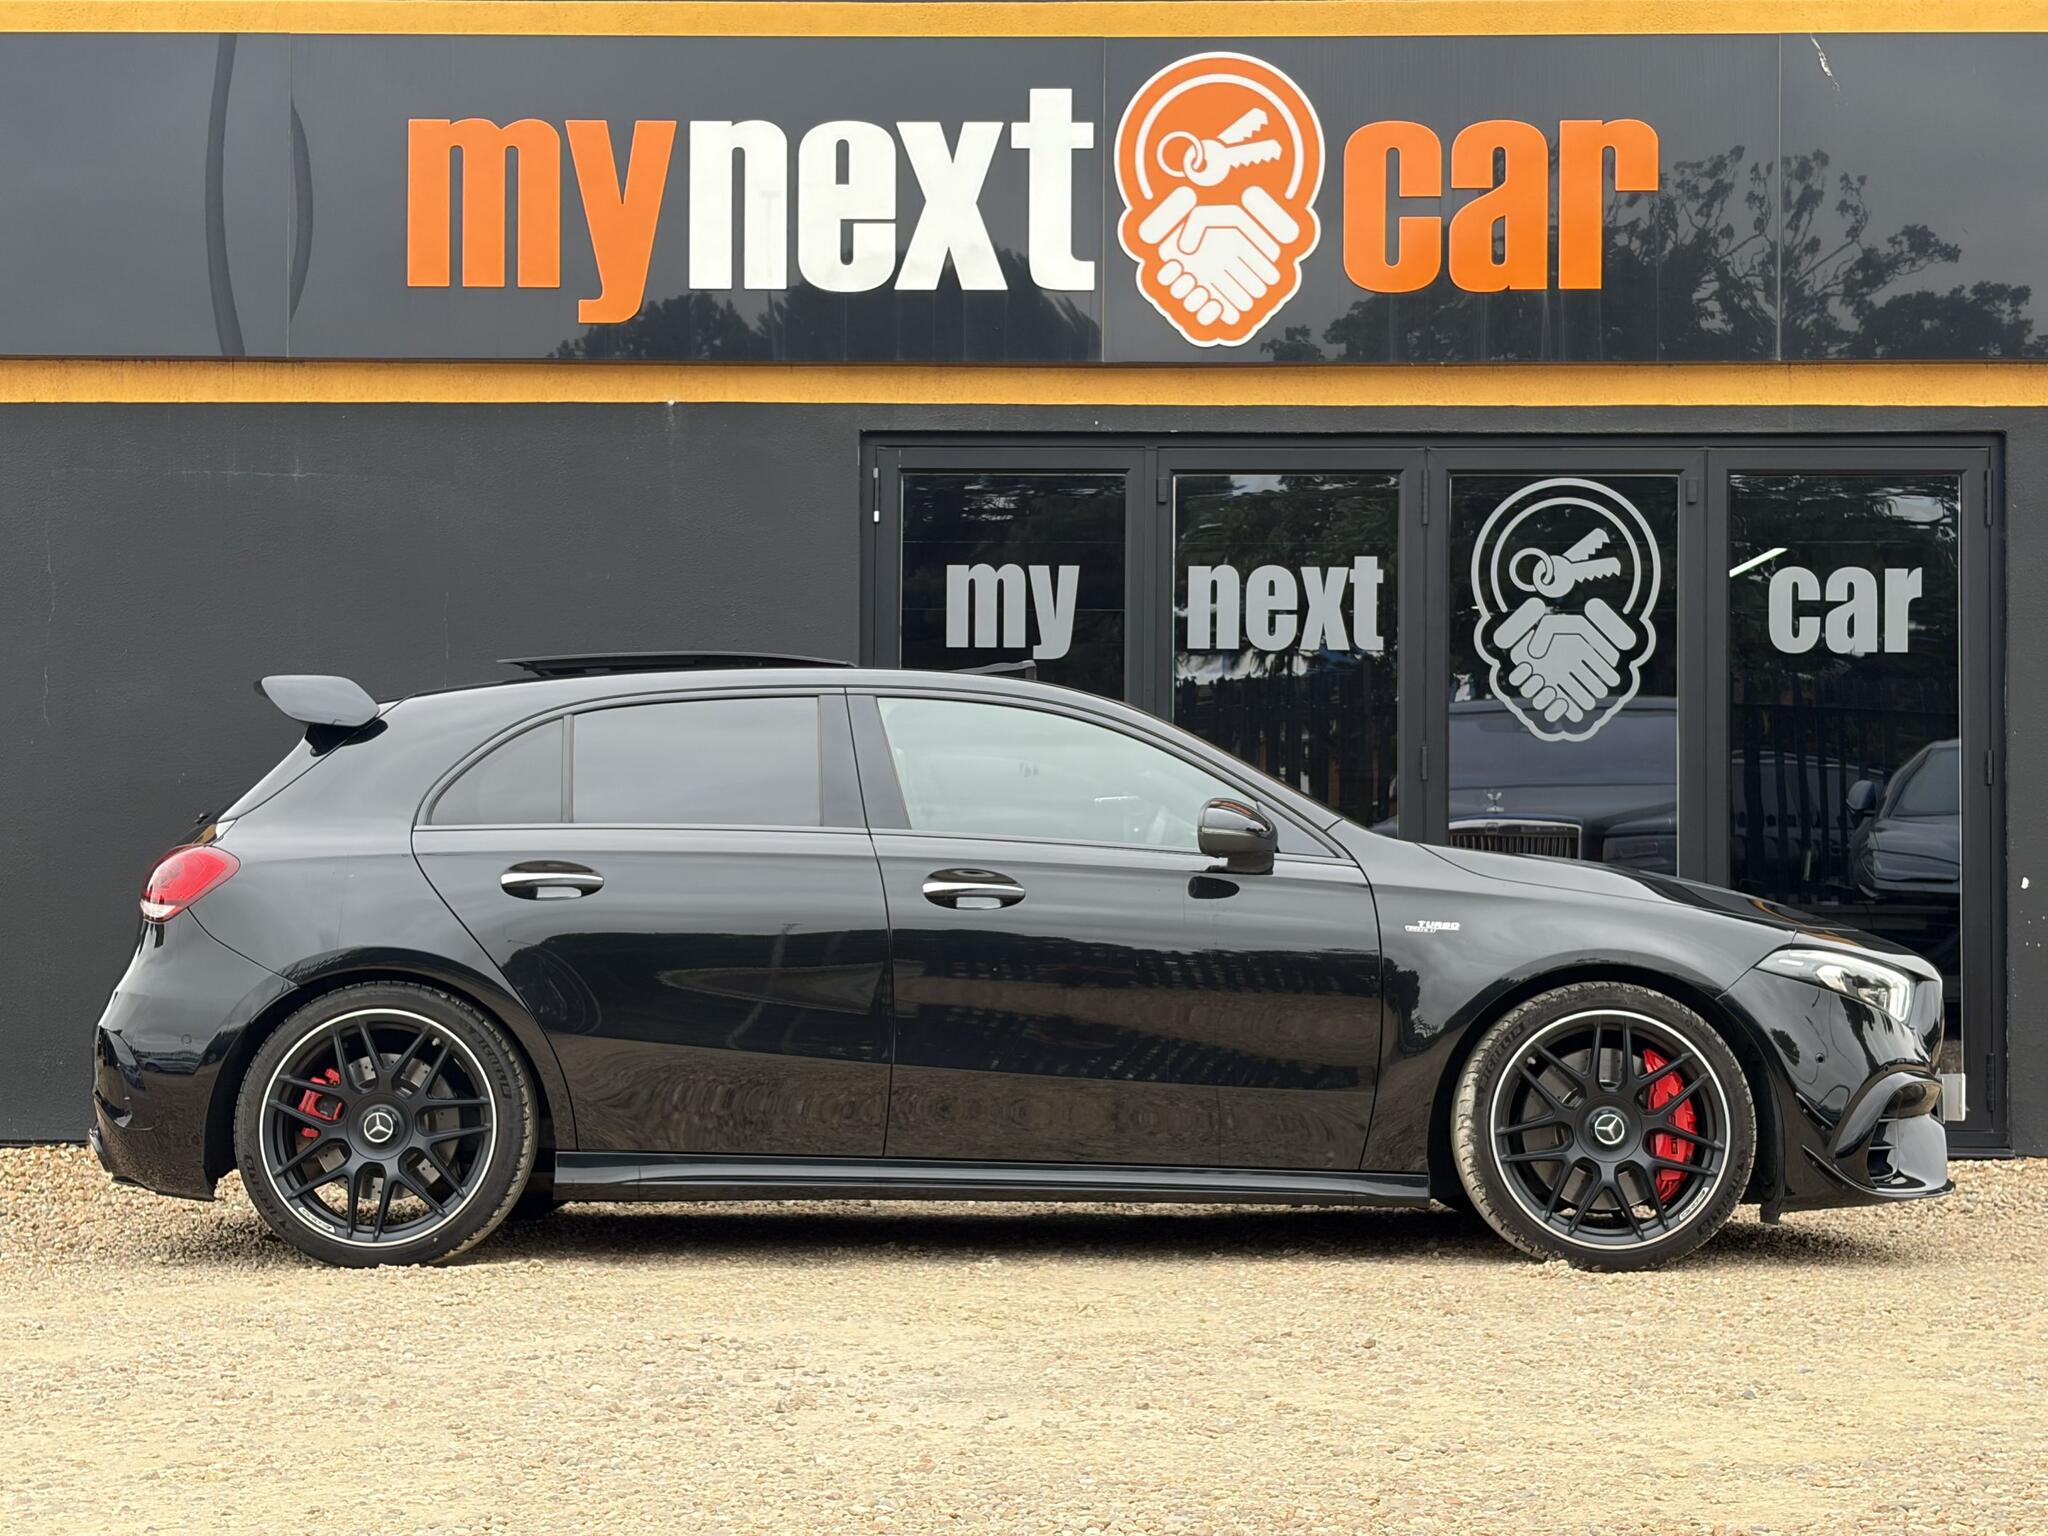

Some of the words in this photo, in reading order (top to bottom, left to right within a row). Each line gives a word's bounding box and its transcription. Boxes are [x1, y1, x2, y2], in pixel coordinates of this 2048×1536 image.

[407, 118, 677, 324] my
[688, 88, 1095, 293] next
[1343, 119, 1659, 293] car
[945, 563, 1080, 660] my
[1187, 556, 1384, 651] next
[1768, 566, 1923, 655] car
